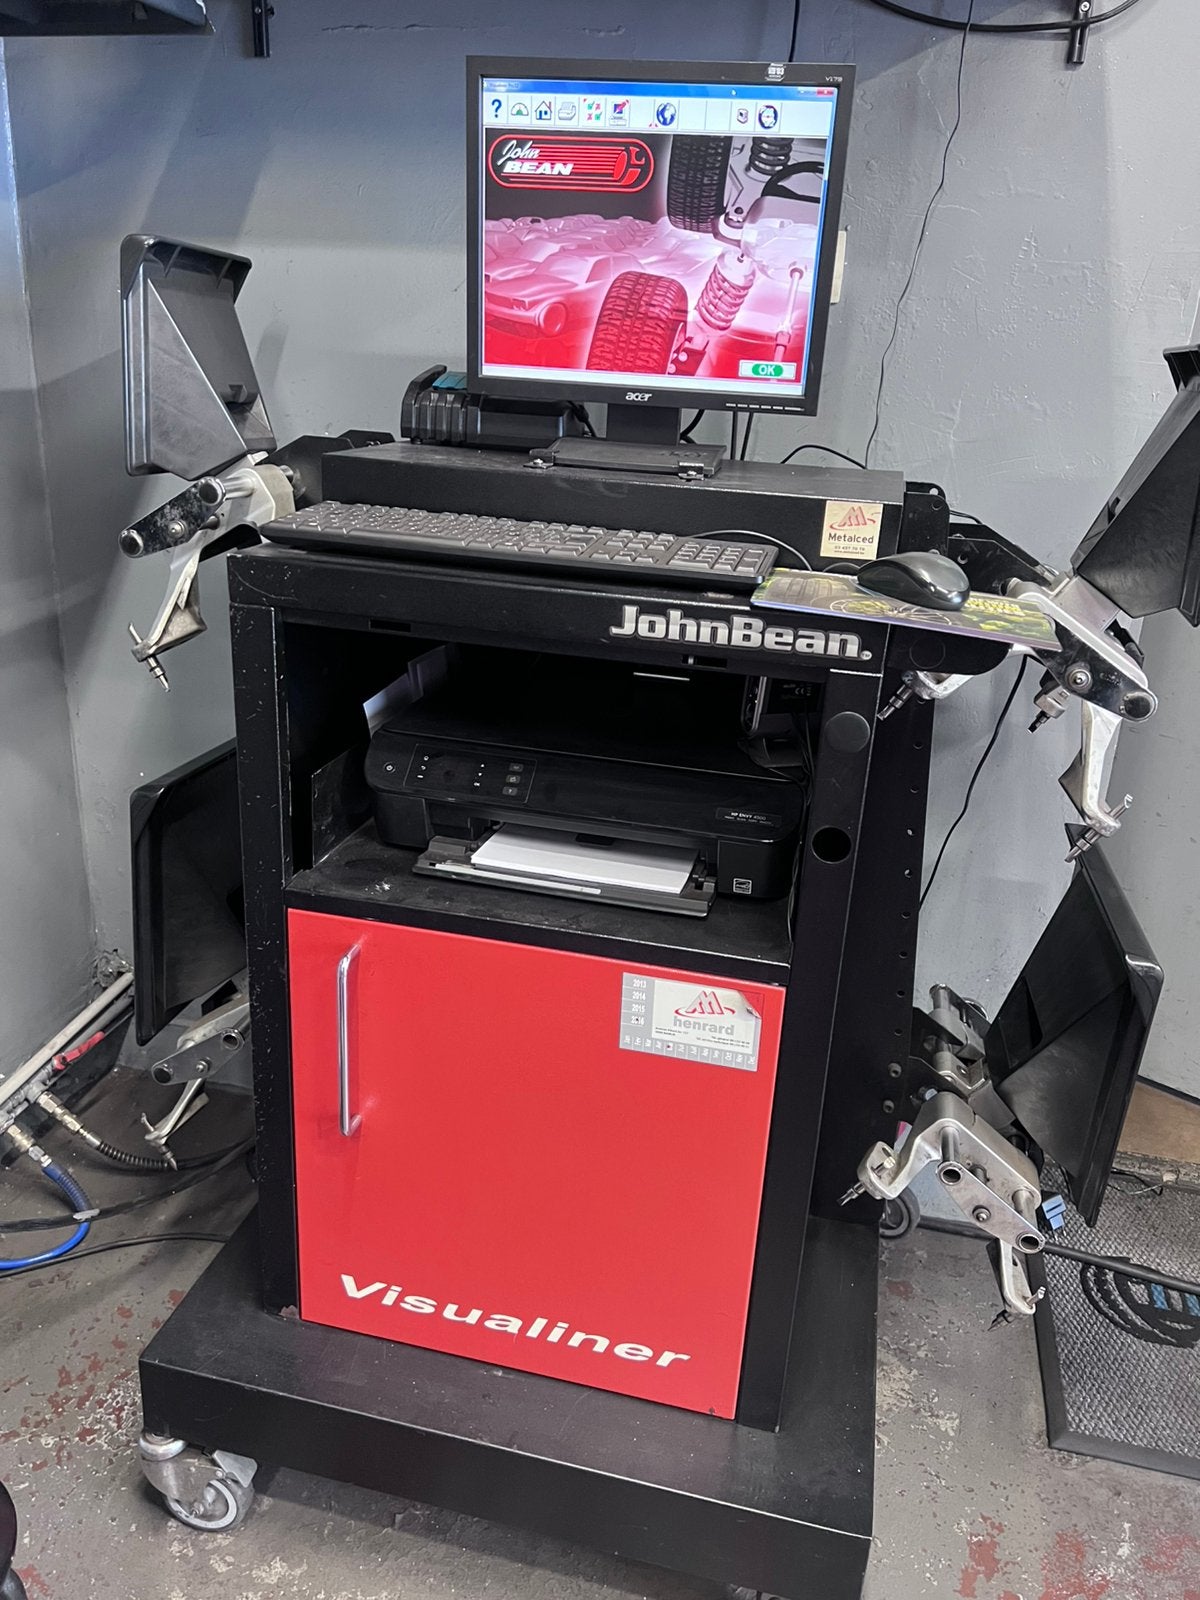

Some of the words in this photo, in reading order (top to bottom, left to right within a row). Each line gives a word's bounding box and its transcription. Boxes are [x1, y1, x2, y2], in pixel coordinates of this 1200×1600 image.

[497, 140, 540, 165] John
[503, 161, 574, 175] BEAN
[758, 364, 775, 376] OK
[625, 392, 652, 402] acer
[828, 532, 874, 543] Metalced
[609, 605, 861, 658] JohnBean
[632, 990, 646, 1001] 2014
[673, 1016, 735, 1036] henrard
[340, 1274, 691, 1368] Visualiner
